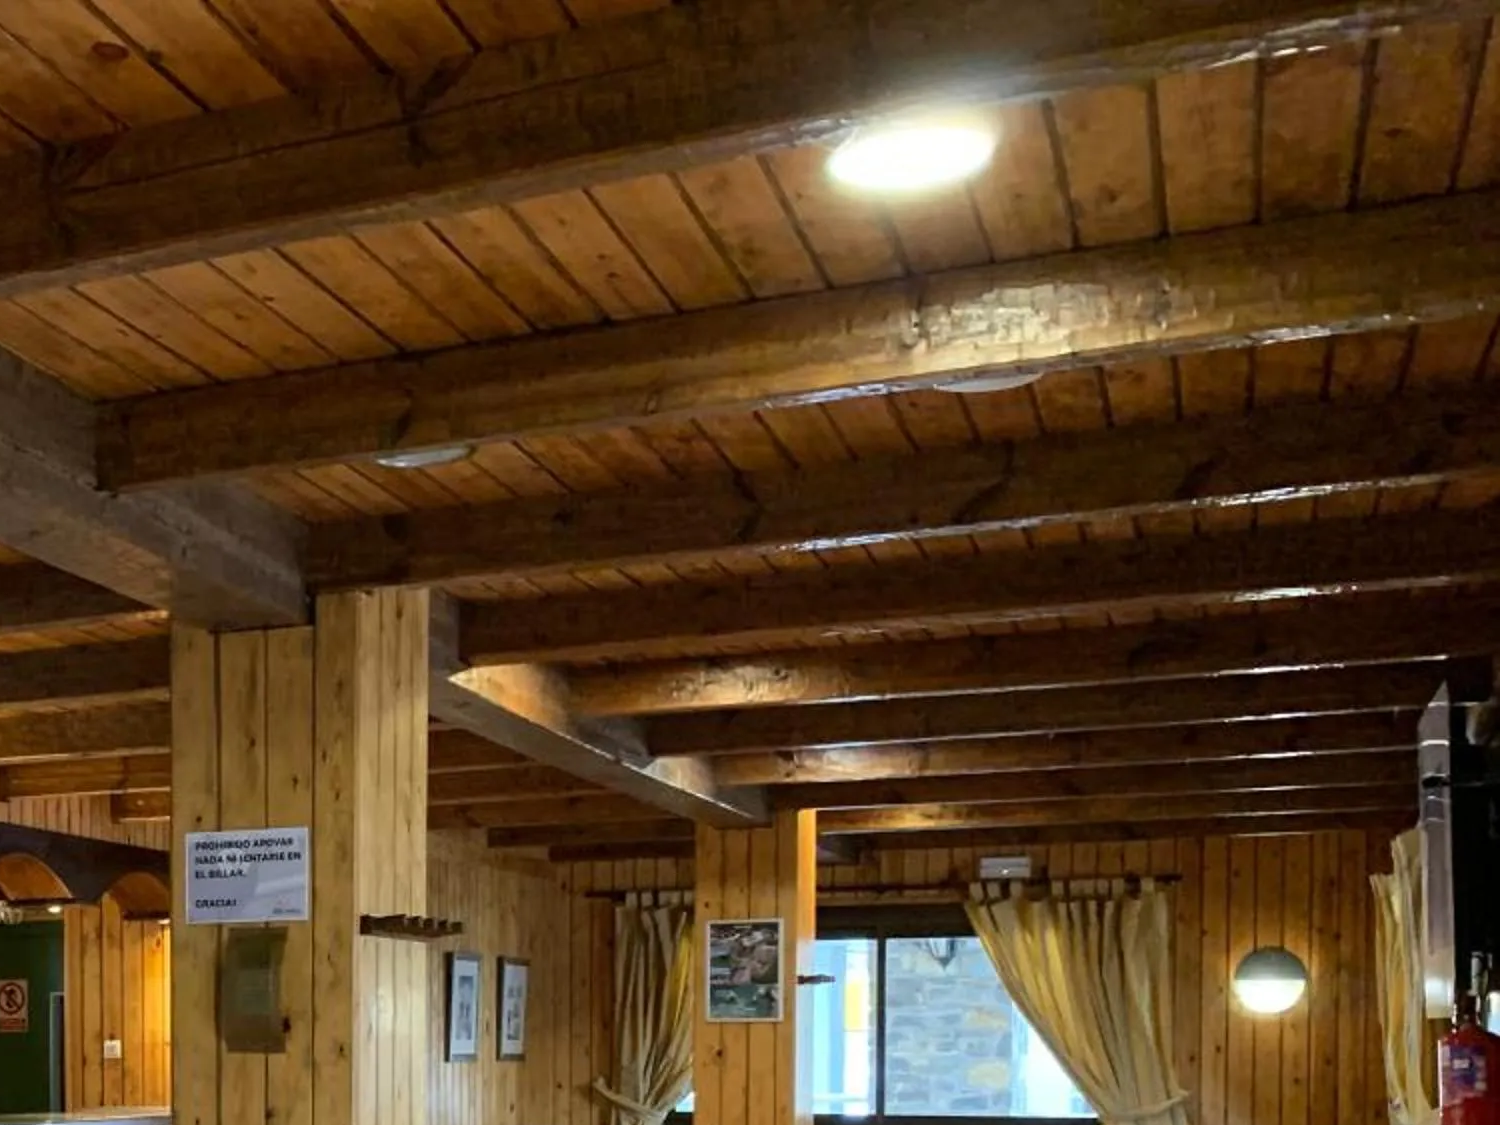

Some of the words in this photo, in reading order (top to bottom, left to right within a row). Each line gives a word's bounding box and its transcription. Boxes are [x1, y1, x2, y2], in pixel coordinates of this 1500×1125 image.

[195, 854, 223, 864] NADA
[287, 851, 301, 861] EN
[195, 869, 206, 879] EL
